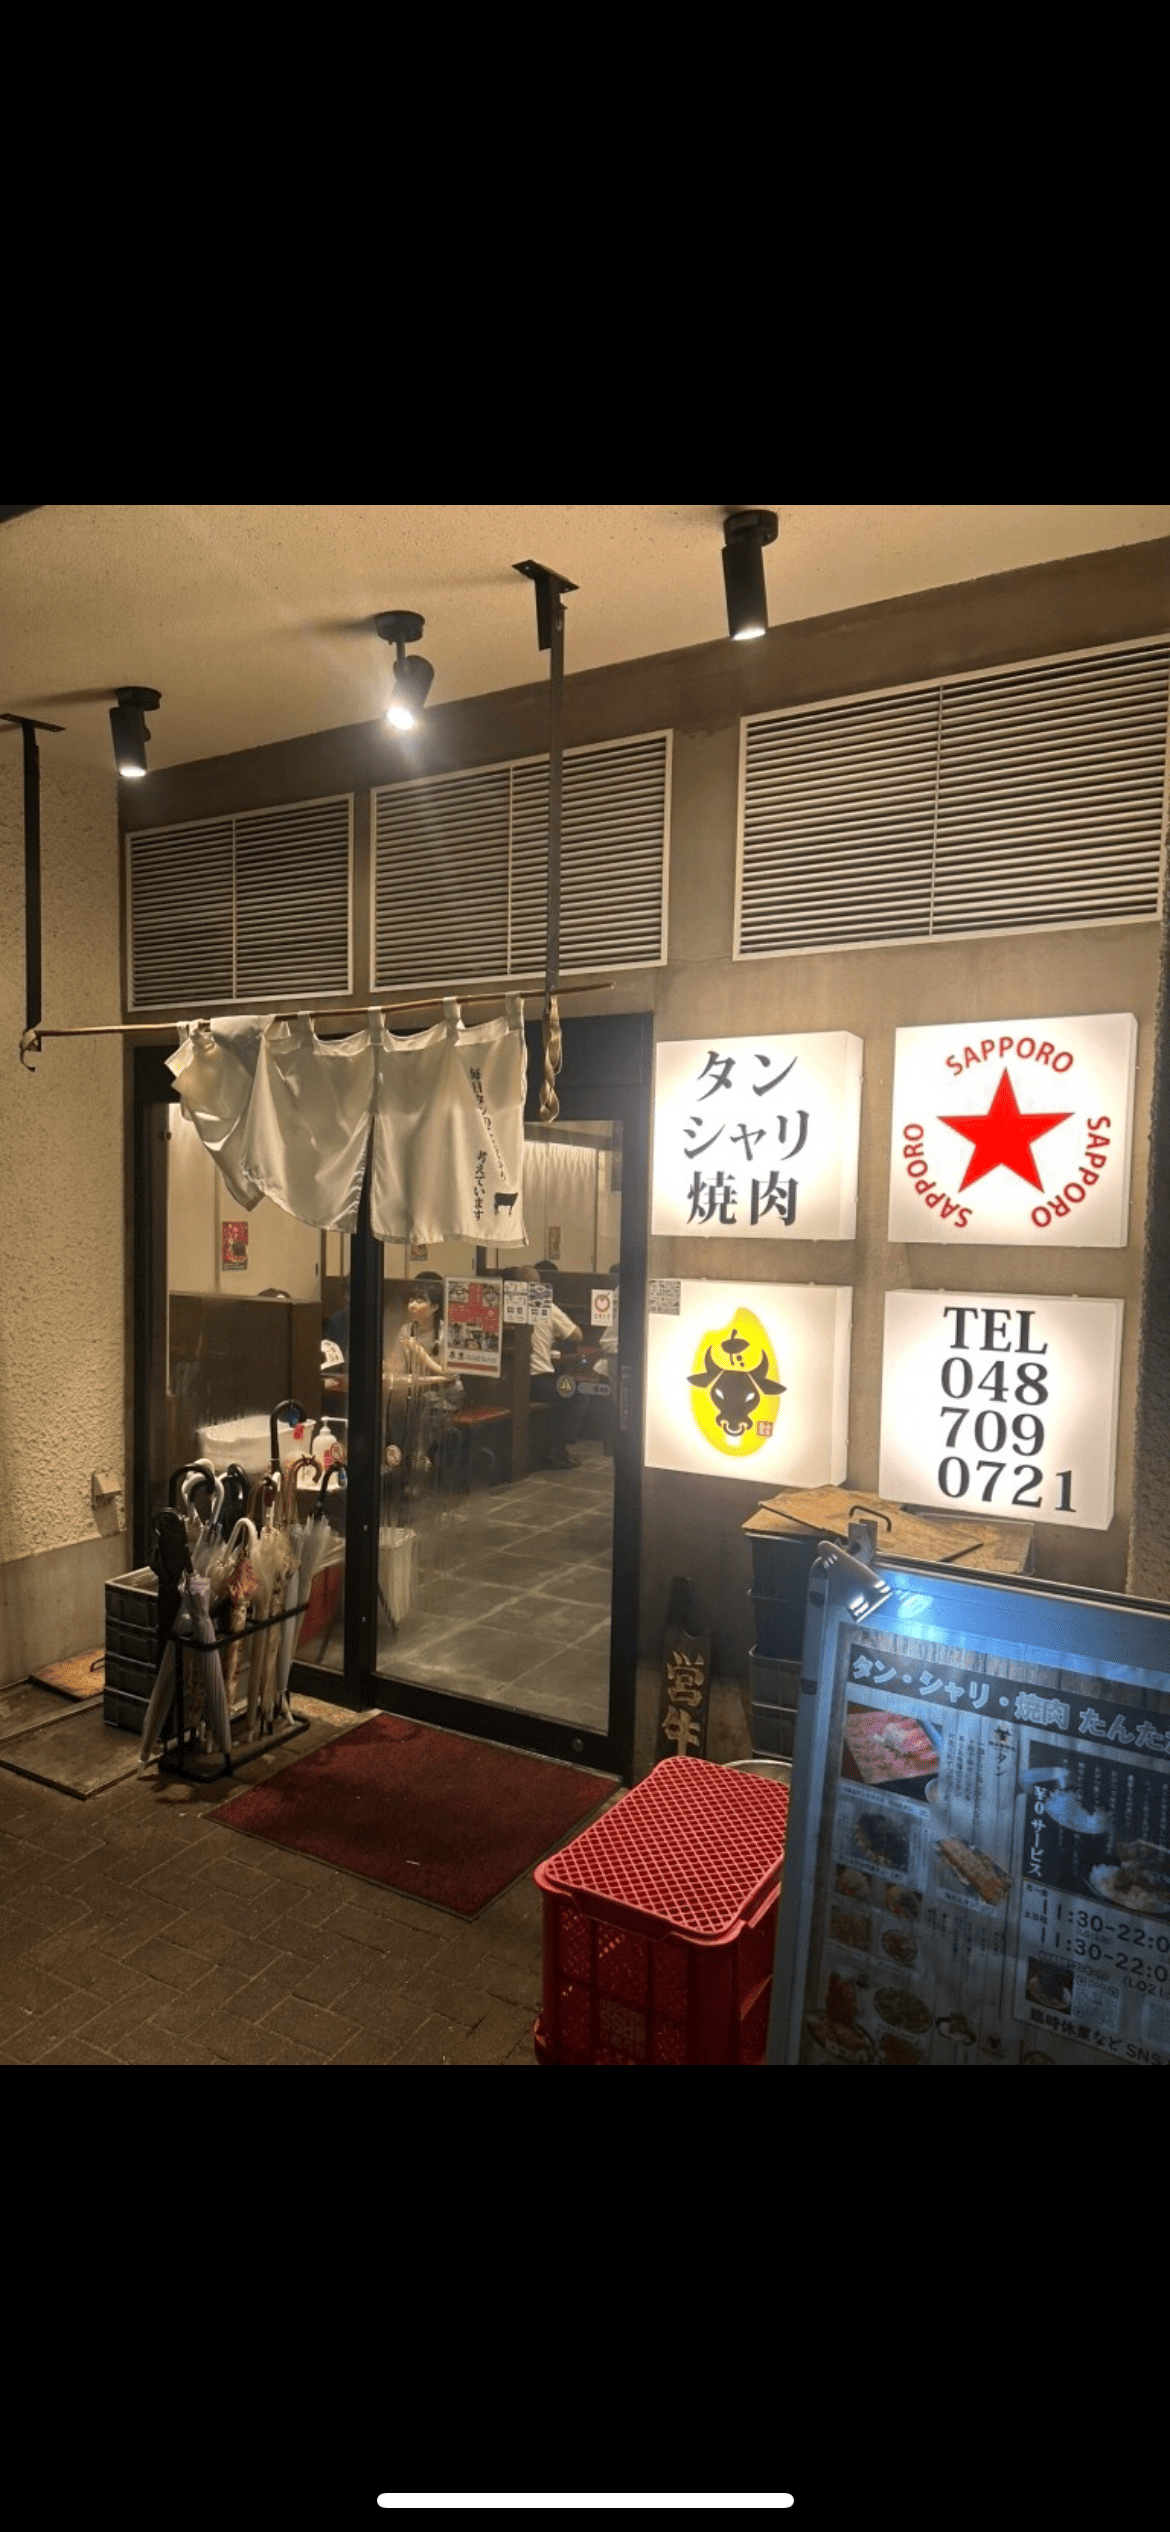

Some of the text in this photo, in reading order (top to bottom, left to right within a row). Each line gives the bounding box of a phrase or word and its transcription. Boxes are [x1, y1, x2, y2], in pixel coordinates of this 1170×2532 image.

[696, 1050, 799, 1101] タン
[945, 1035, 1074, 1076] SAPPORO
[682, 1110, 810, 1162] シャリ
[473, 1151, 488, 1221] 考えています
[902, 1123, 973, 1229] SAPPORO
[1030, 1115, 1111, 1229] SAPPORO
[687, 1170, 800, 1227] 焼肉
[943, 1306, 1049, 1355] TEL
[940, 1357, 1049, 1405] 048
[939, 1406, 1046, 1456] 709
[937, 1456, 1077, 1513] 0721
[1078, 1707, 1170, 1752] たんた
